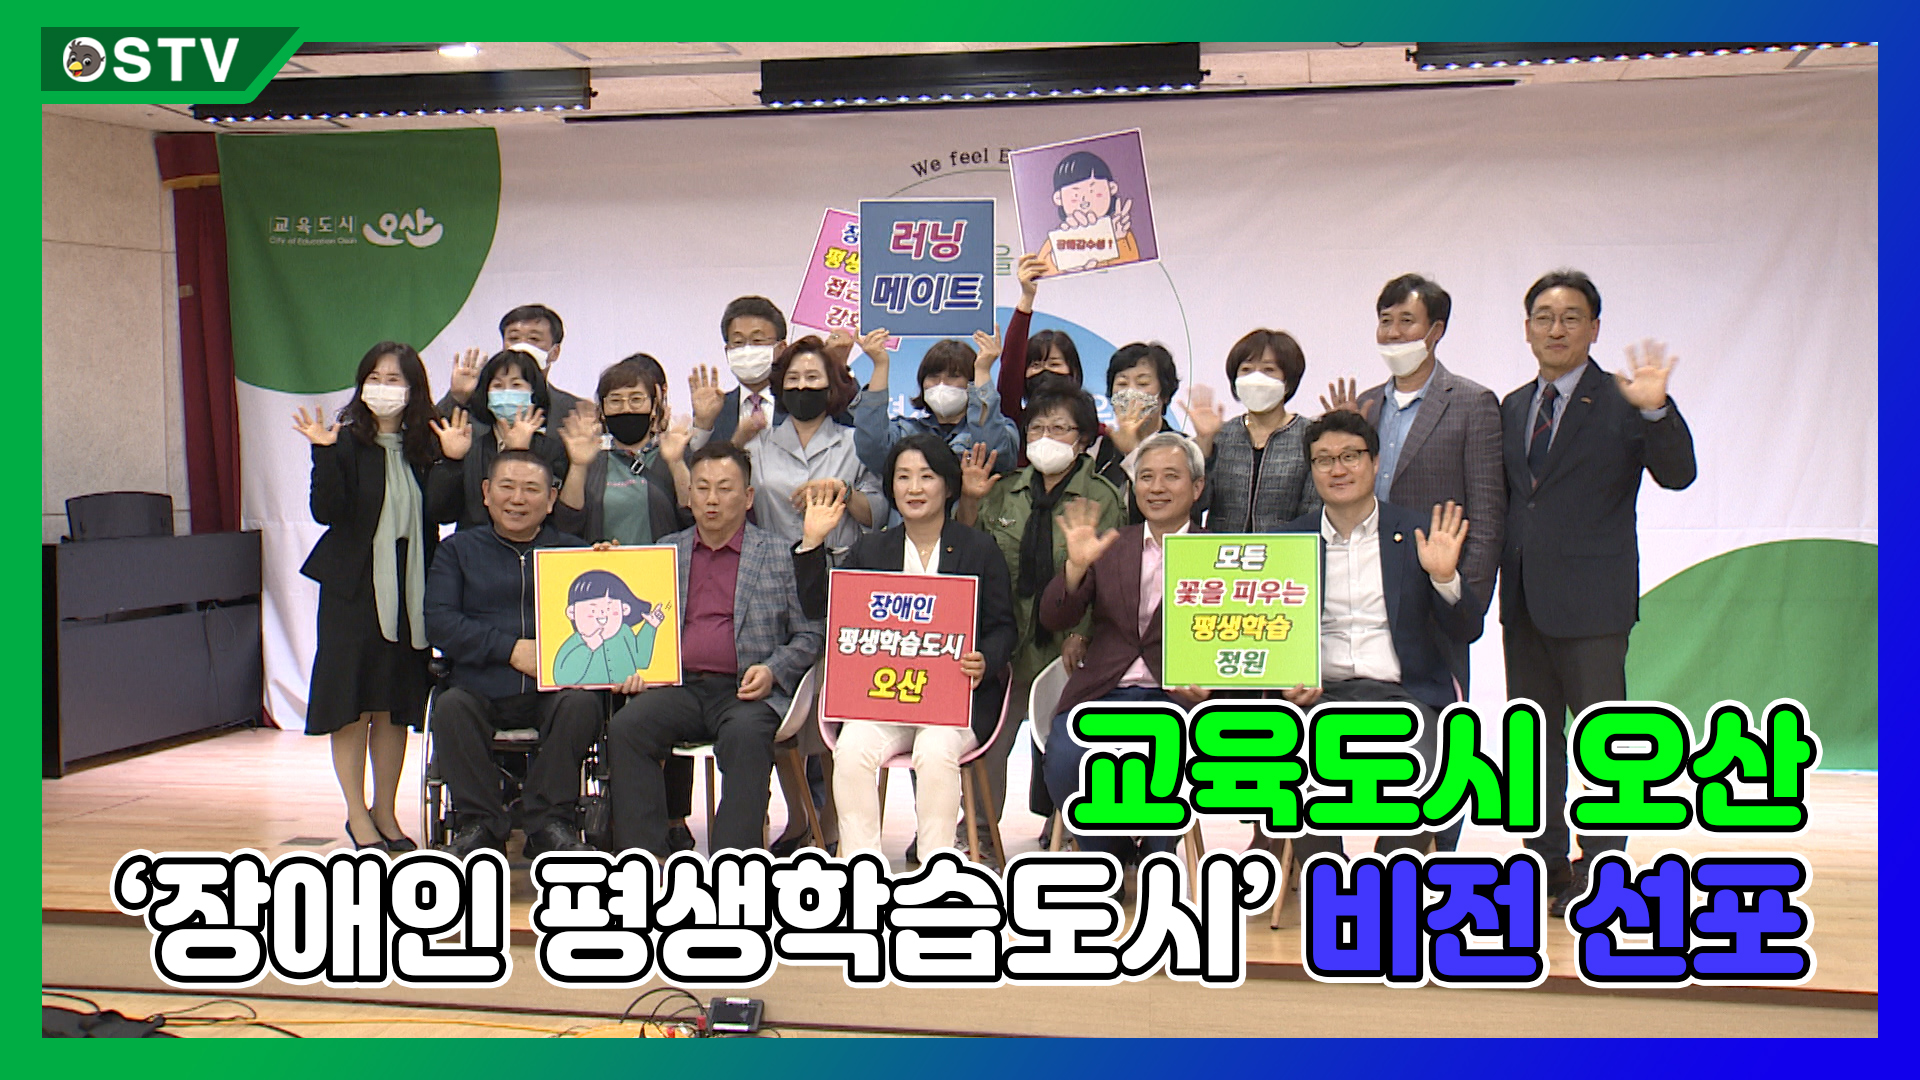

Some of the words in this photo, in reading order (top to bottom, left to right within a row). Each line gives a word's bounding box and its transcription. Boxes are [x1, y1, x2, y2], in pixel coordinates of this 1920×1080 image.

[910, 159, 942, 178] We
[949, 147, 989, 166] feel
[272, 215, 354, 236] 교육도시
[362, 207, 444, 248] 오산
[890, 220, 968, 261] 러닝
[871, 273, 984, 314] 메이트
[1213, 543, 1268, 571] 모든
[868, 591, 937, 624] 장애인
[1174, 578, 1227, 607] 꽃을
[1231, 578, 1309, 607] 피우는
[1191, 613, 1293, 642] 평생학습
[837, 627, 966, 662] 평생학습도시
[1214, 649, 1269, 677] 정원
[867, 666, 929, 704] 오산
